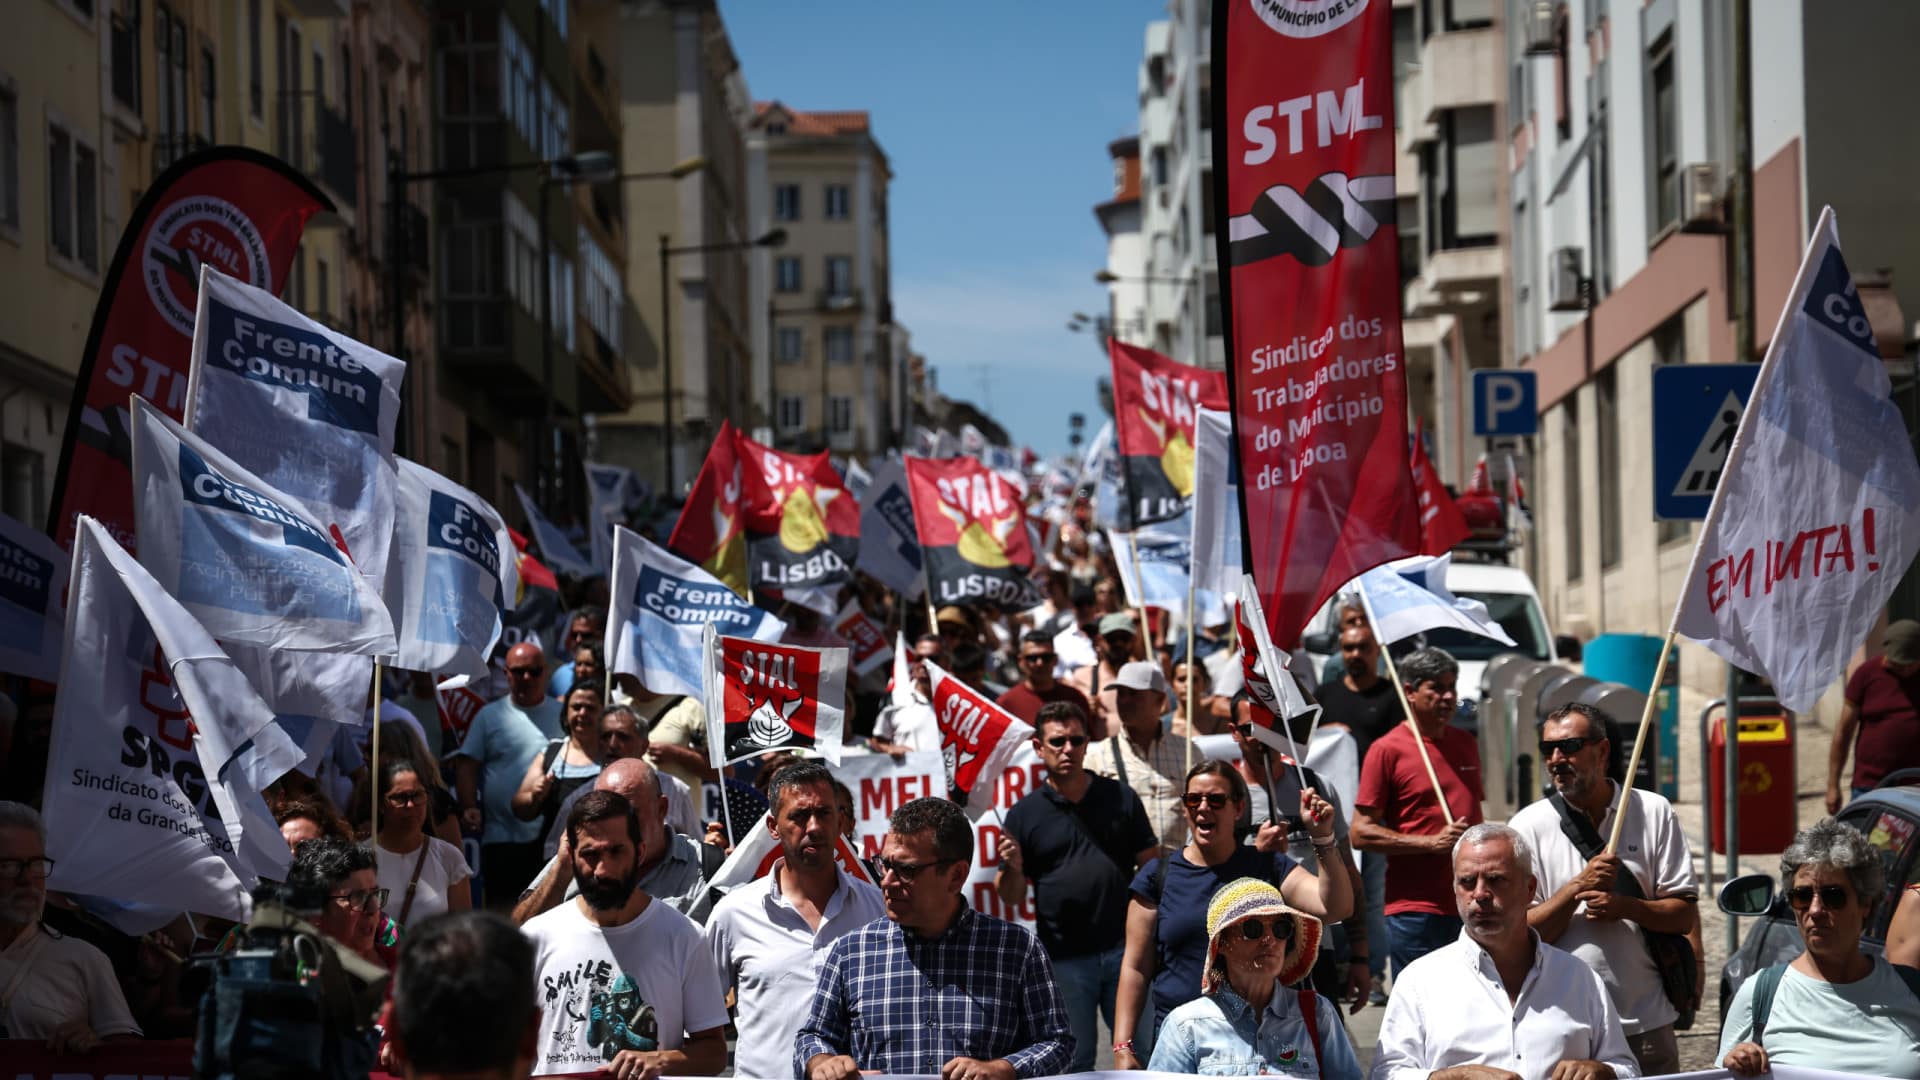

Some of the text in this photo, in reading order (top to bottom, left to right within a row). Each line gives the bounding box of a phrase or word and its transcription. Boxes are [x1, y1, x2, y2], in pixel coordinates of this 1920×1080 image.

[1268, 0, 1326, 26] MUNICÍPIO
[1328, 2, 1345, 20] DE
[1243, 76, 1383, 166] STML
[187, 226, 241, 273] STML
[233, 316, 363, 375] Frente
[1339, 313, 1383, 340] dos
[222, 339, 367, 404] Comum
[1485, 375, 1525, 432] P
[1255, 425, 1282, 452] do
[936, 471, 1009, 518] STAL
[1257, 463, 1283, 491] de
[761, 549, 849, 584] LISBO
[1705, 547, 1755, 615] EM
[645, 592, 750, 626] Comum
[739, 649, 798, 690] STAL
[941, 692, 990, 745] STAL
[71, 768, 158, 800] Sindicato
[162, 790, 186, 815] dos
[107, 803, 132, 822] da
[137, 807, 196, 839] Grande
